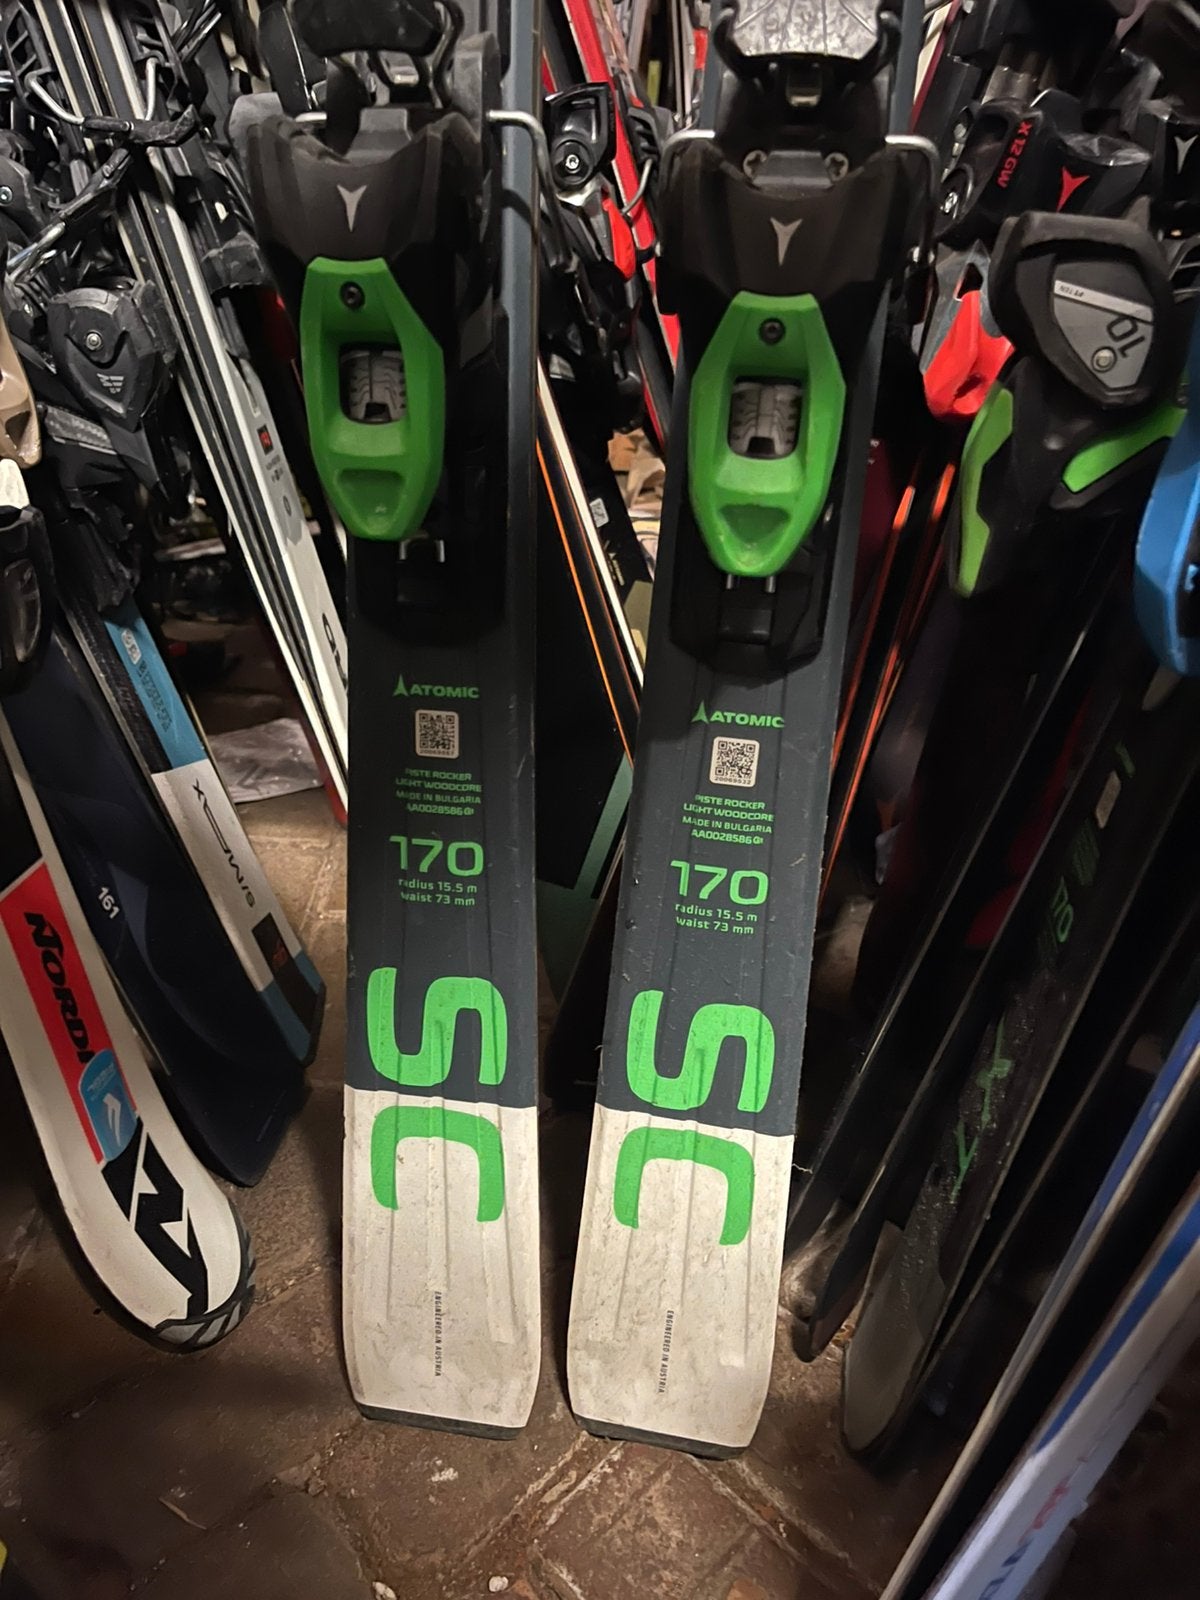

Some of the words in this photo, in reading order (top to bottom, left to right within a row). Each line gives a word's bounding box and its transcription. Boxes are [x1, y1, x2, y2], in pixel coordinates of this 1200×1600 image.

[1017, 122, 1032, 136] X
[998, 157, 1017, 189] GW
[1106, 317, 1146, 358] 10
[410, 684, 480, 698] ATOMIC
[710, 711, 785, 728] ATOMIC
[432, 771, 472, 781] ROCKER
[424, 782, 482, 793] WOODCORE
[435, 794, 482, 804] BULGARIA
[695, 794, 723, 806] PISTE
[724, 799, 766, 810] ROCKER
[683, 803, 713, 815] LIGHT
[714, 808, 774, 822] WOODCORE
[682, 815, 710, 827] MADE
[712, 820, 722, 829] IN
[724, 822, 773, 834] BULGARIA
[389, 835, 484, 877] 170
[398, 878, 434, 891] radius
[437, 881, 464, 893] 15.5
[467, 885, 478, 894] m
[670, 860, 769, 906] 170
[98, 887, 120, 919] 161
[400, 891, 432, 903] waist
[435, 894, 451, 905] 73
[454, 897, 476, 906] mm
[675, 904, 713, 917] radius
[716, 908, 744, 922] 15.5
[747, 913, 758, 922] m
[676, 916, 710, 930] waist
[713, 921, 729, 932] 73
[732, 925, 754, 935] mm
[366, 966, 508, 1222] SC
[613, 989, 776, 1246] SC
[434, 1291, 443, 1335] ENGINEERED
[434, 1336, 443, 1344] IN
[662, 1310, 675, 1353] ENGINEERED
[434, 1345, 443, 1377] AUSTRIA
[661, 1353, 669, 1362] IN
[658, 1363, 669, 1394] AUSTRIA
